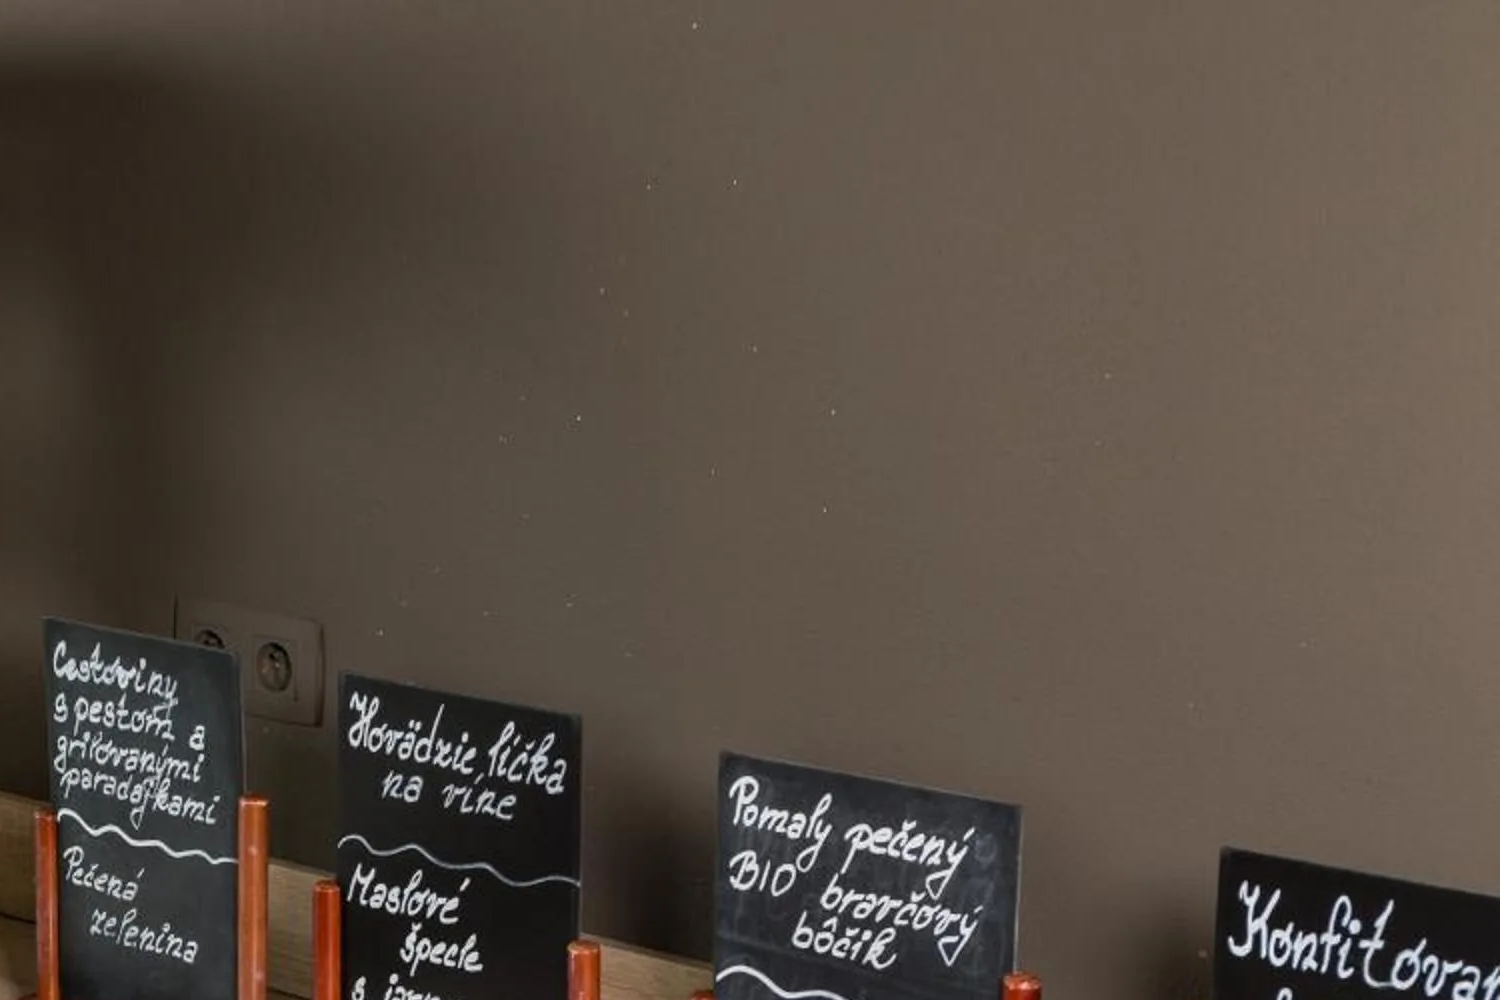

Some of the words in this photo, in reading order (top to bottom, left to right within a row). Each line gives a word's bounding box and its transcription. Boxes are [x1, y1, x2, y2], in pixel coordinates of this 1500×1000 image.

[53, 640, 179, 718] Cestoviny
[53, 692, 68, 722] s
[74, 693, 175, 740] pestom
[189, 725, 205, 750] a
[348, 691, 477, 774] Hovädzie
[488, 721, 568, 794] líčka
[53, 731, 205, 786] grilovanými
[60, 768, 221, 830] paradajkami
[381, 769, 423, 803] na
[442, 773, 517, 820] víne
[729, 775, 833, 872] Pomaly
[844, 820, 976, 898] pečený
[63, 845, 145, 901] Pečená
[348, 862, 470, 925] Maslové
[90, 907, 198, 963] zelenina
[729, 850, 798, 897] BIO
[820, 869, 983, 967] bravčový
[399, 922, 484, 977] špecle
[792, 912, 897, 970] bôčik
